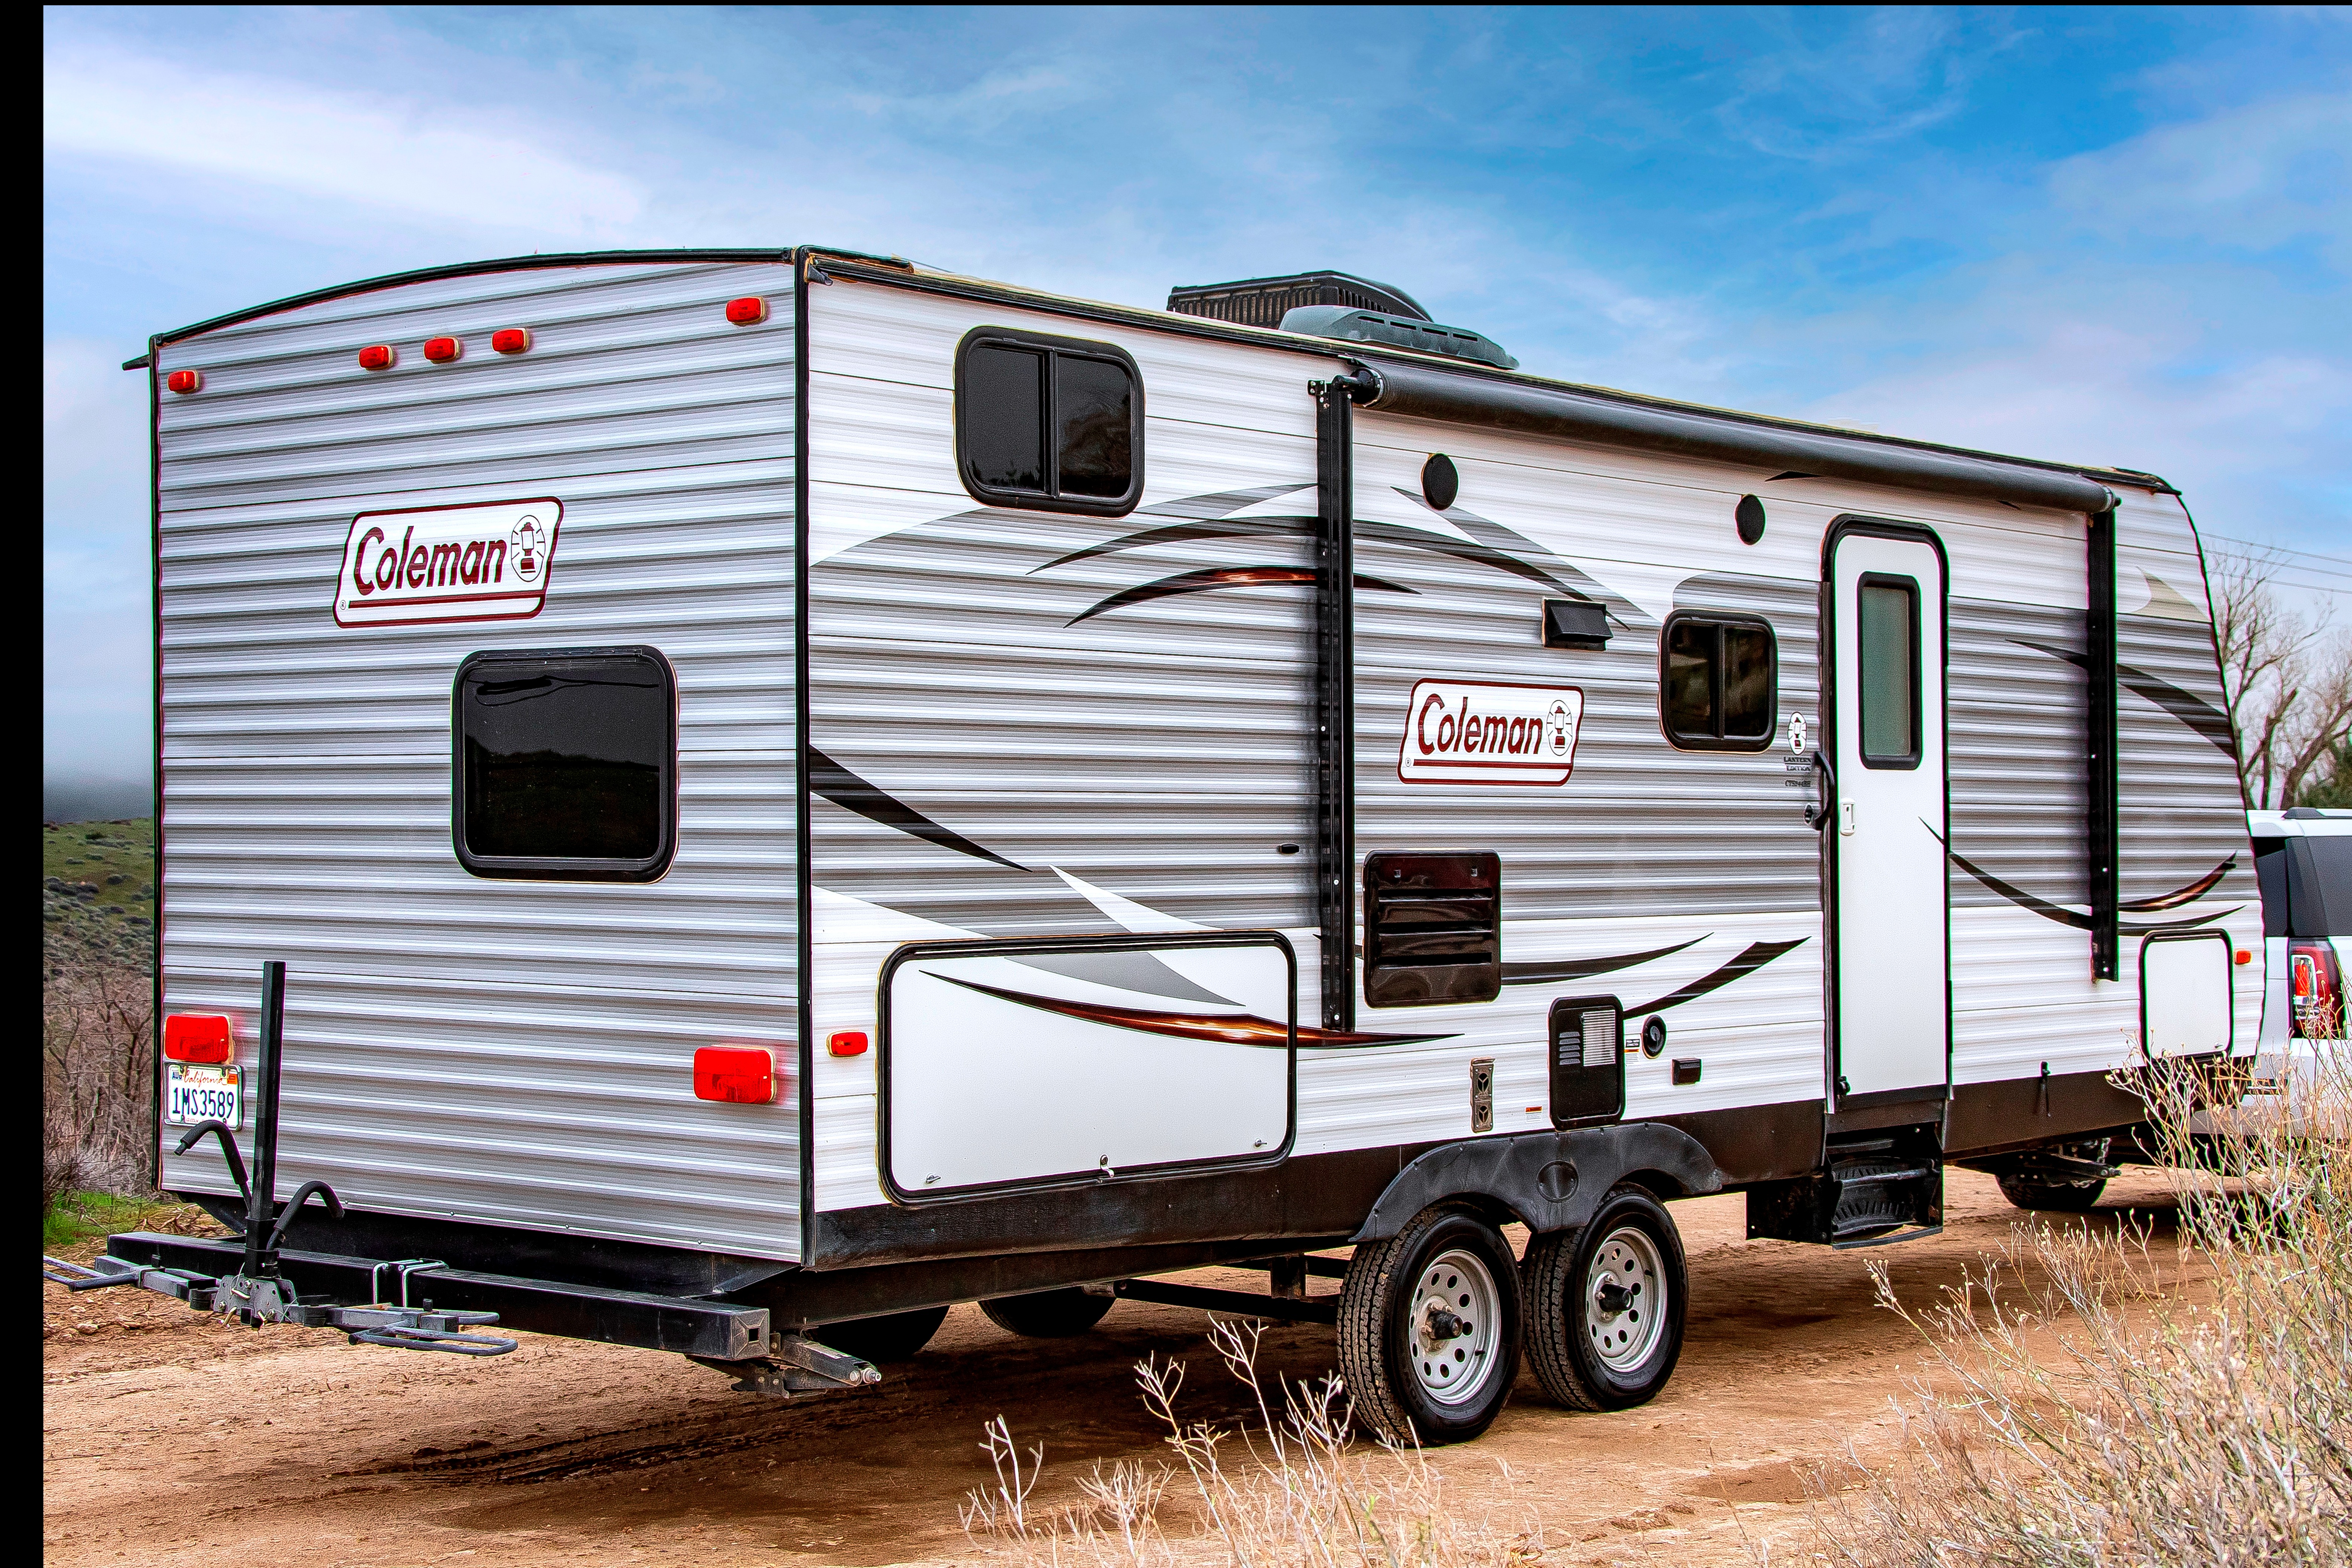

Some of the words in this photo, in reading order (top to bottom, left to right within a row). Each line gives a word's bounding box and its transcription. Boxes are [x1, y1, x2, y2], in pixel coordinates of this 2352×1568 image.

[353, 525, 507, 596] Coleman
[1418, 693, 1543, 755] Coleman
[184, 1069, 228, 1088] California
[172, 1087, 234, 1119] 1MS3589
